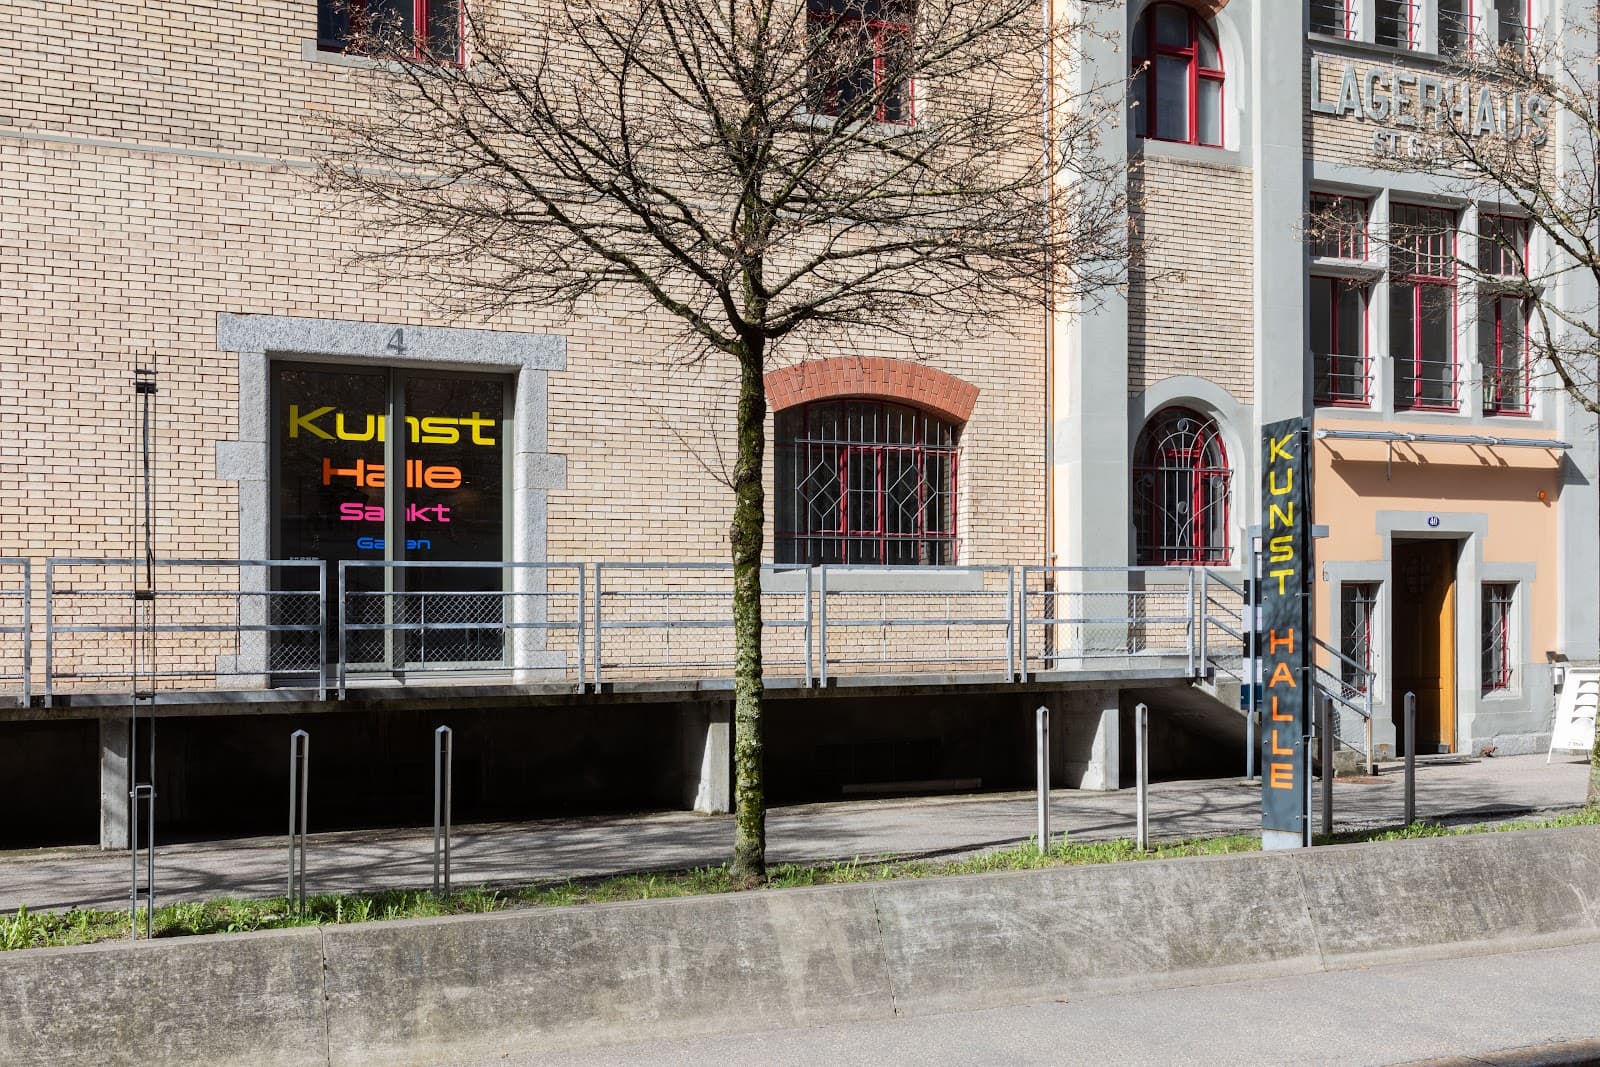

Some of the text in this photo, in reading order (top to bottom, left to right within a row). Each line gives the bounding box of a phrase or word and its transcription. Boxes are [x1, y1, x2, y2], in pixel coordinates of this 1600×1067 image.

[1310, 55, 1548, 145] LAGERHAUS
[387, 328, 408, 355] 4
[340, 502, 451, 523] Sakt
[356, 537, 431, 550] Gaen
[1268, 433, 1297, 790] KUNST HALLE
